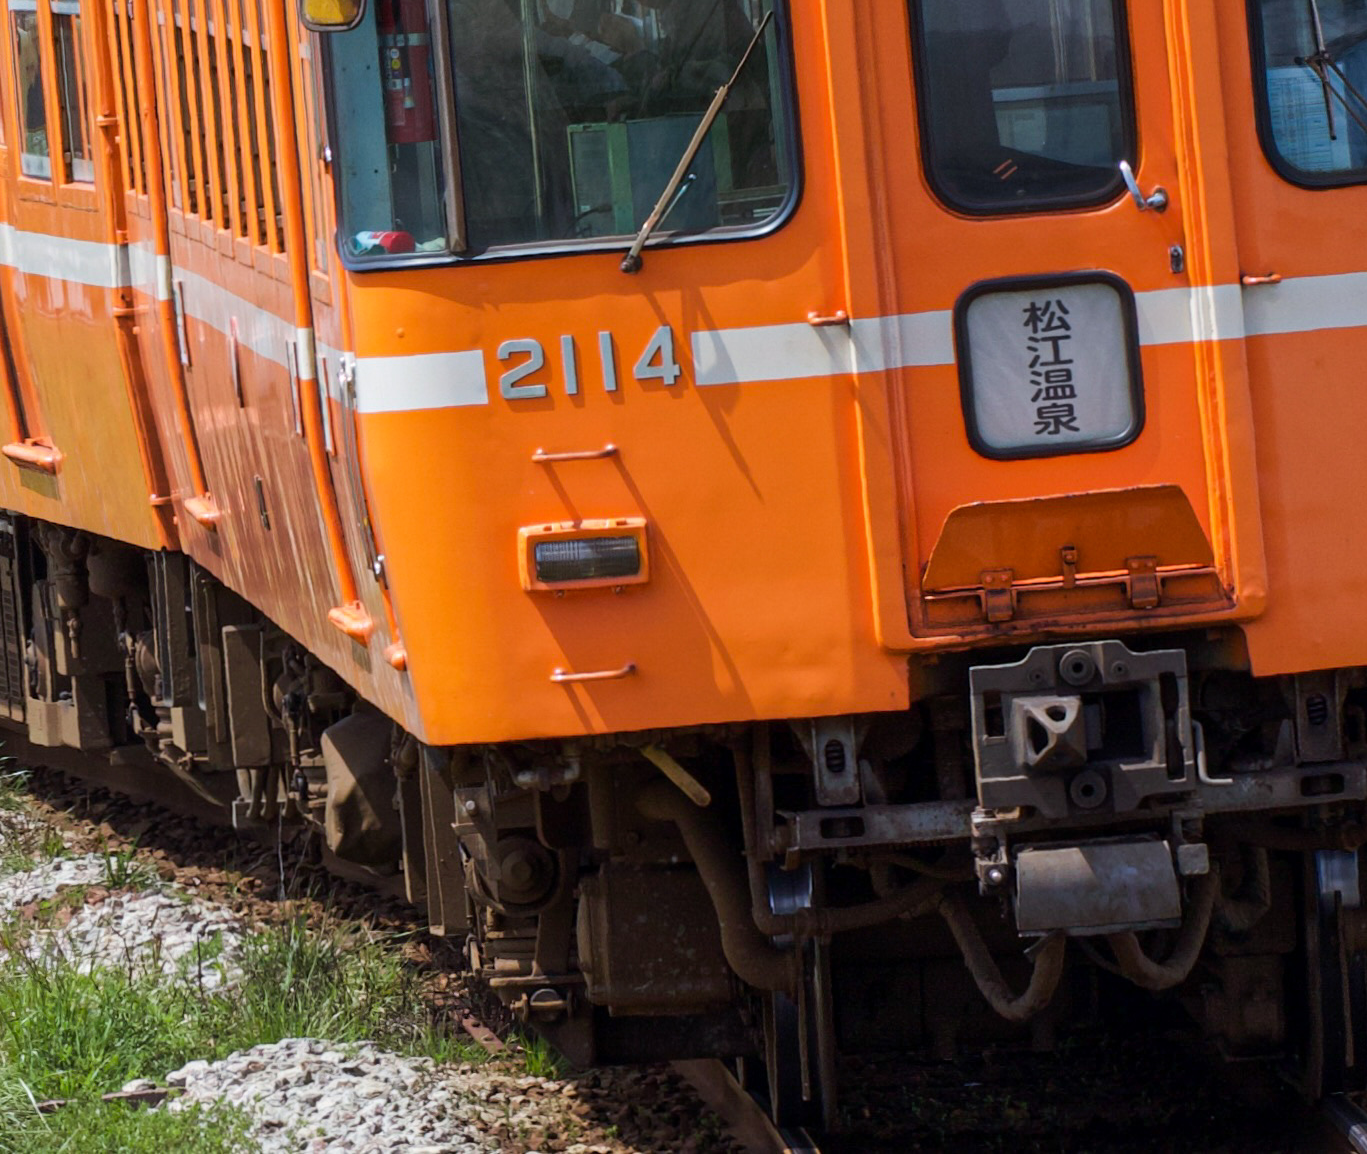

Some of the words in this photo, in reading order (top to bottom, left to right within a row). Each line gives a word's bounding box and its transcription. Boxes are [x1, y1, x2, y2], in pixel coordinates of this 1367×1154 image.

[497, 325, 681, 399] 2114
[1022, 299, 1081, 435] 松江温泉
